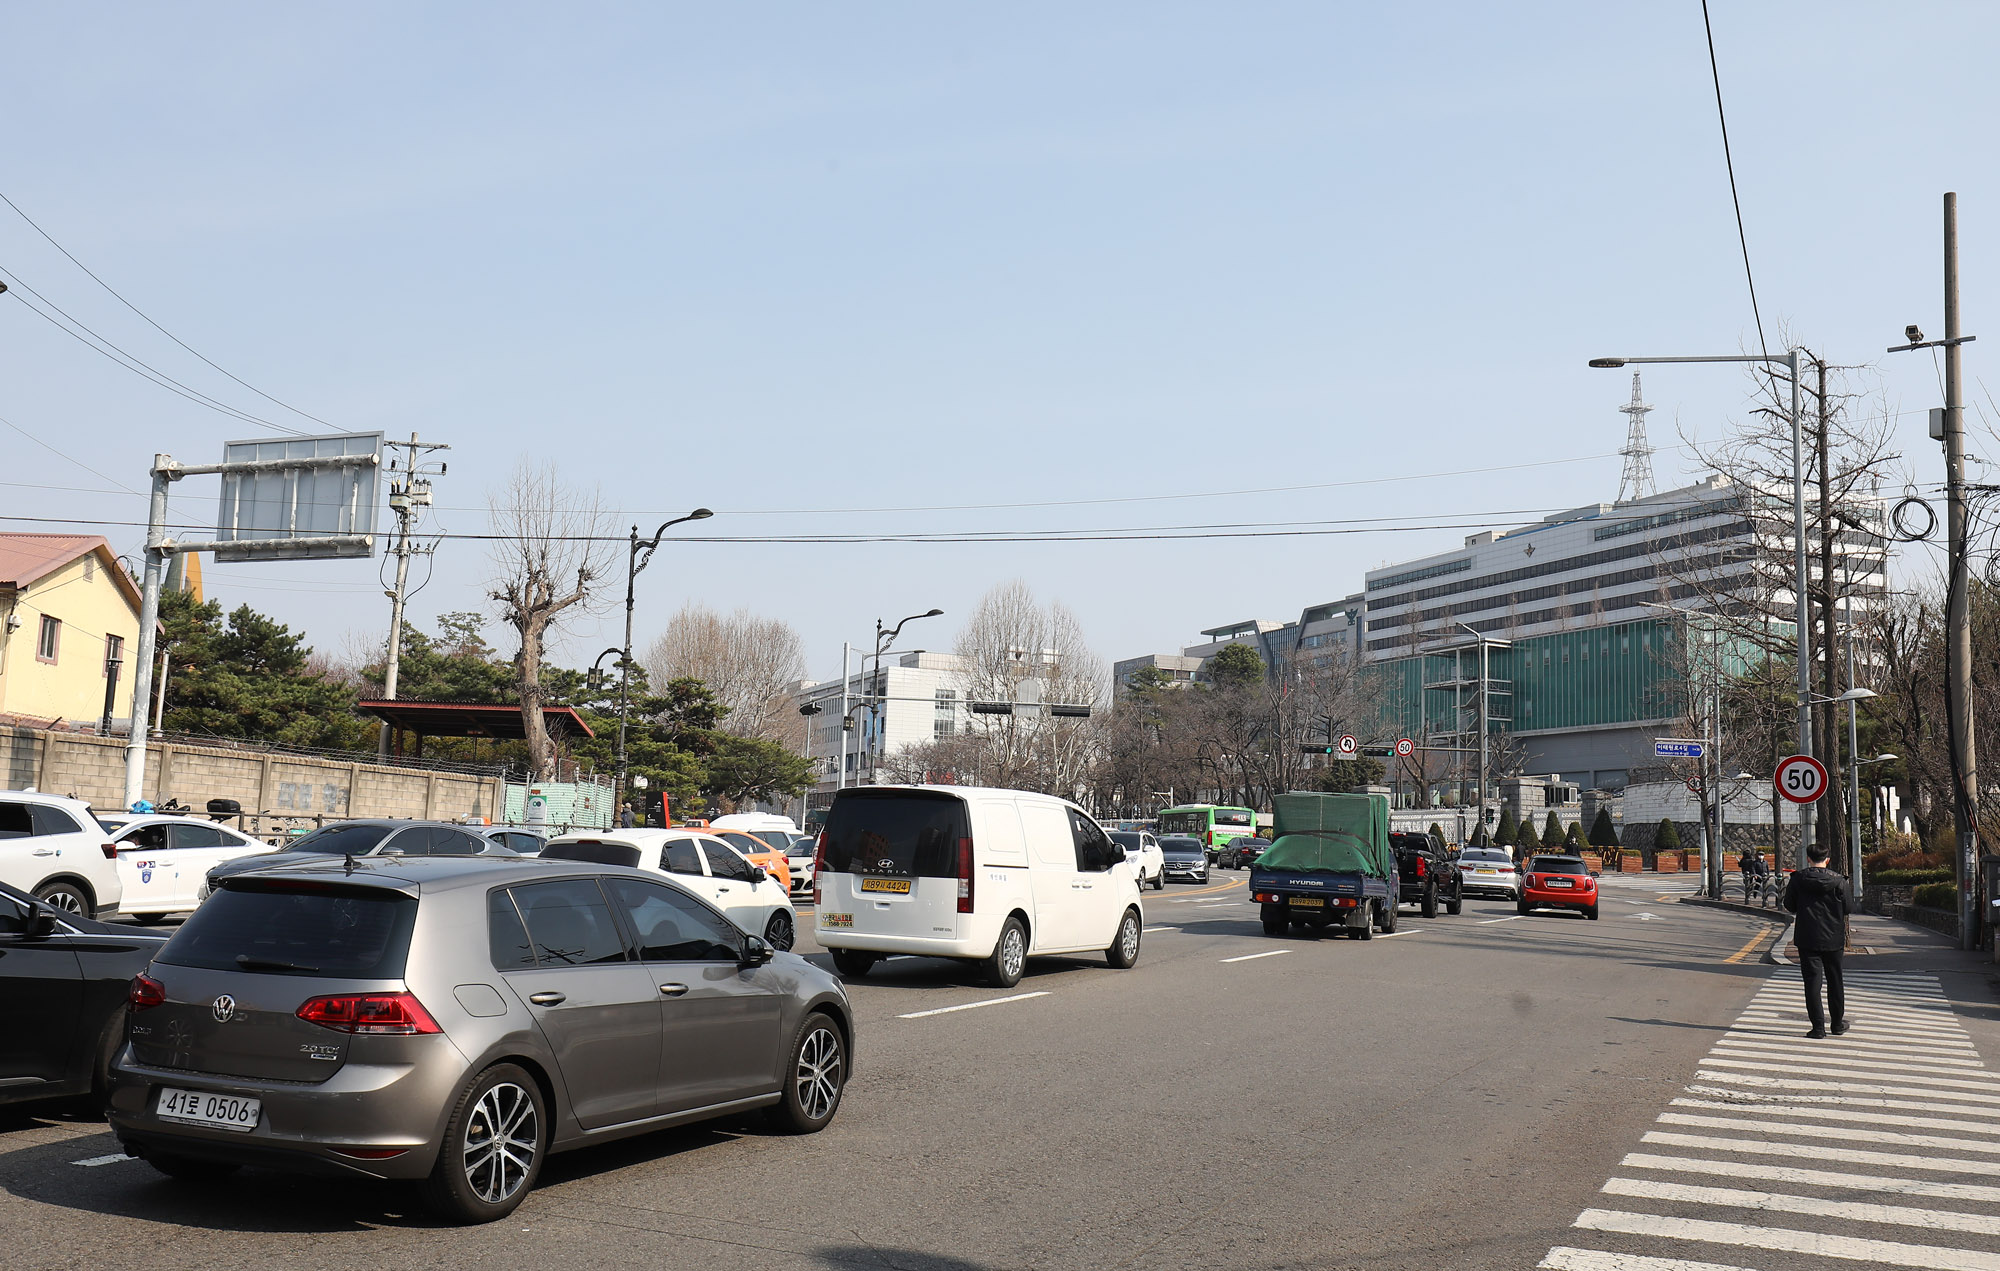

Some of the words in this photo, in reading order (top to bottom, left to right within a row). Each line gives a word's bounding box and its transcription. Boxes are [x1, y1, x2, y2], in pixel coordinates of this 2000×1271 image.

[1400, 743, 1410, 752] 50
[1656, 744, 1688, 752] 이태원로4길
[1787, 769, 1815, 791] 50
[886, 881, 907, 891] 4424
[1289, 879, 1324, 887] HYUNDAI
[166, 1092, 200, 1115] 41로
[205, 1097, 249, 1122] 0506
